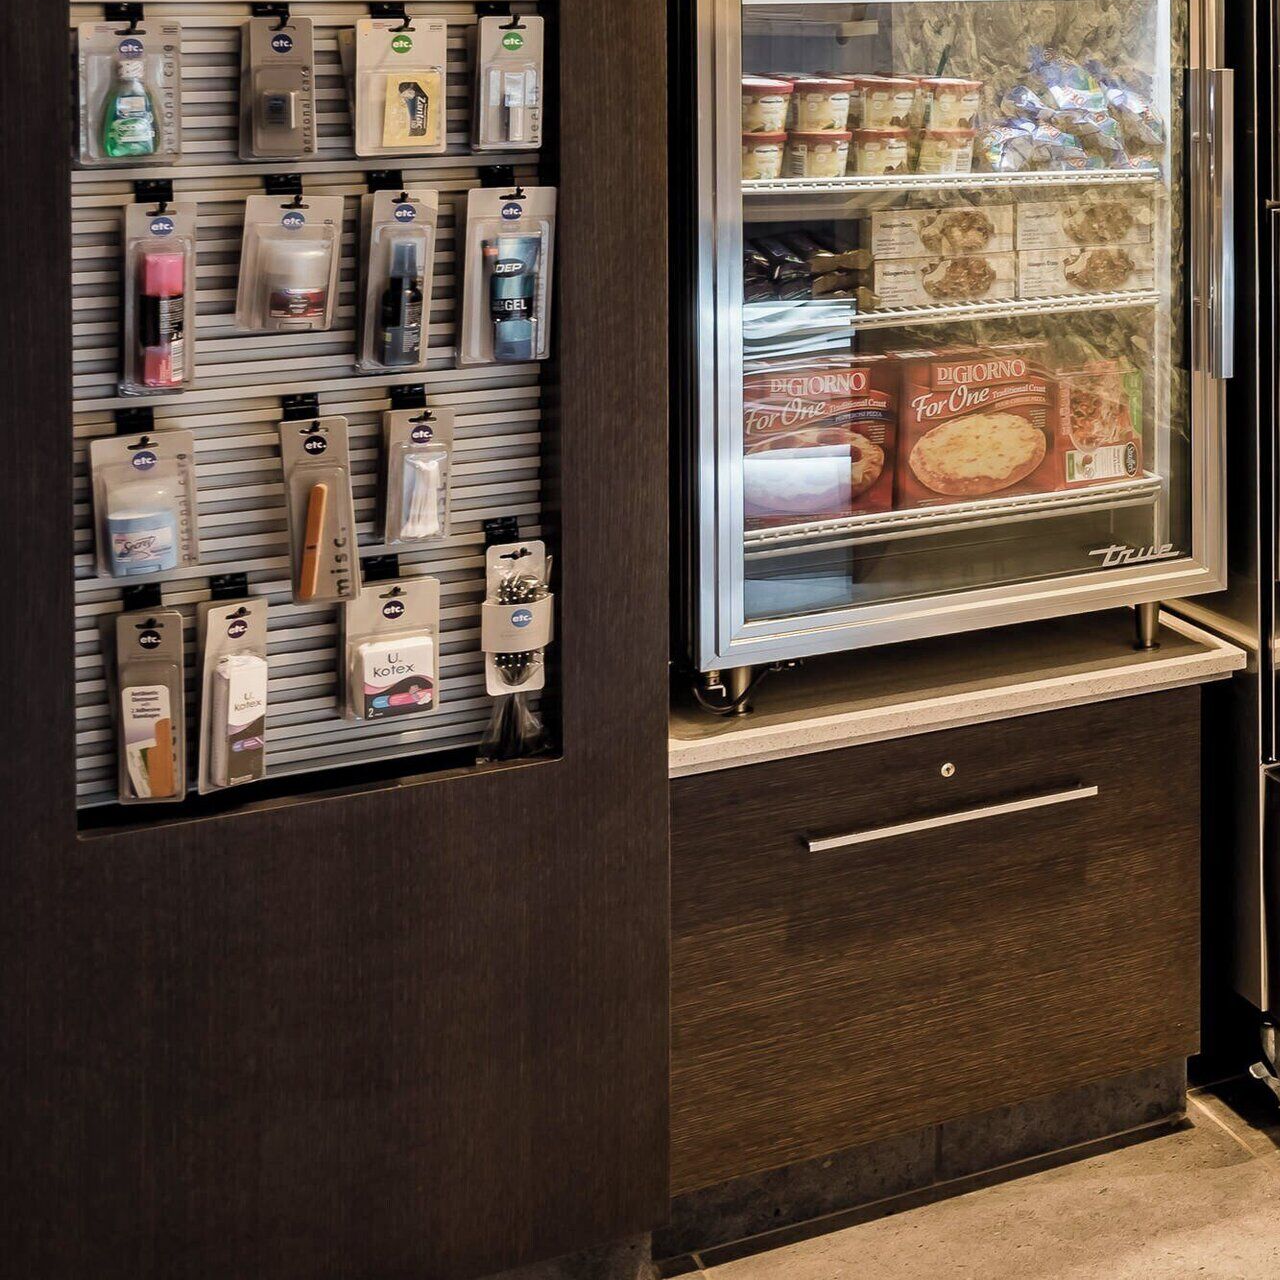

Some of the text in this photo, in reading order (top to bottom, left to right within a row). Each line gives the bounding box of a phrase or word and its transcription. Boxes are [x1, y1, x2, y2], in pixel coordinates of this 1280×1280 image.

[272, 39, 292, 47] etc.
[391, 40, 412, 48] etc.
[503, 38, 523, 46] etc.
[120, 44, 143, 53] etc.
[395, 209, 415, 217] etc.
[502, 208, 522, 216] etc.
[283, 217, 304, 225] etc.
[151, 222, 173, 231] etc.
[495, 263, 523, 272] DEP
[504, 299, 527, 310] GEL
[912, 384, 1046, 422] For One Traditional Crust
[744, 409, 780, 435] For
[781, 398, 826, 426] One
[412, 430, 433, 439] etc.
[305, 441, 326, 449] etc.
[133, 457, 157, 465] etc.
[384, 606, 404, 615] etc.
[512, 615, 532, 623] etc.
[228, 625, 247, 634] etc.
[140, 635, 161, 644] etc.
[373, 663, 414, 678] kotex
